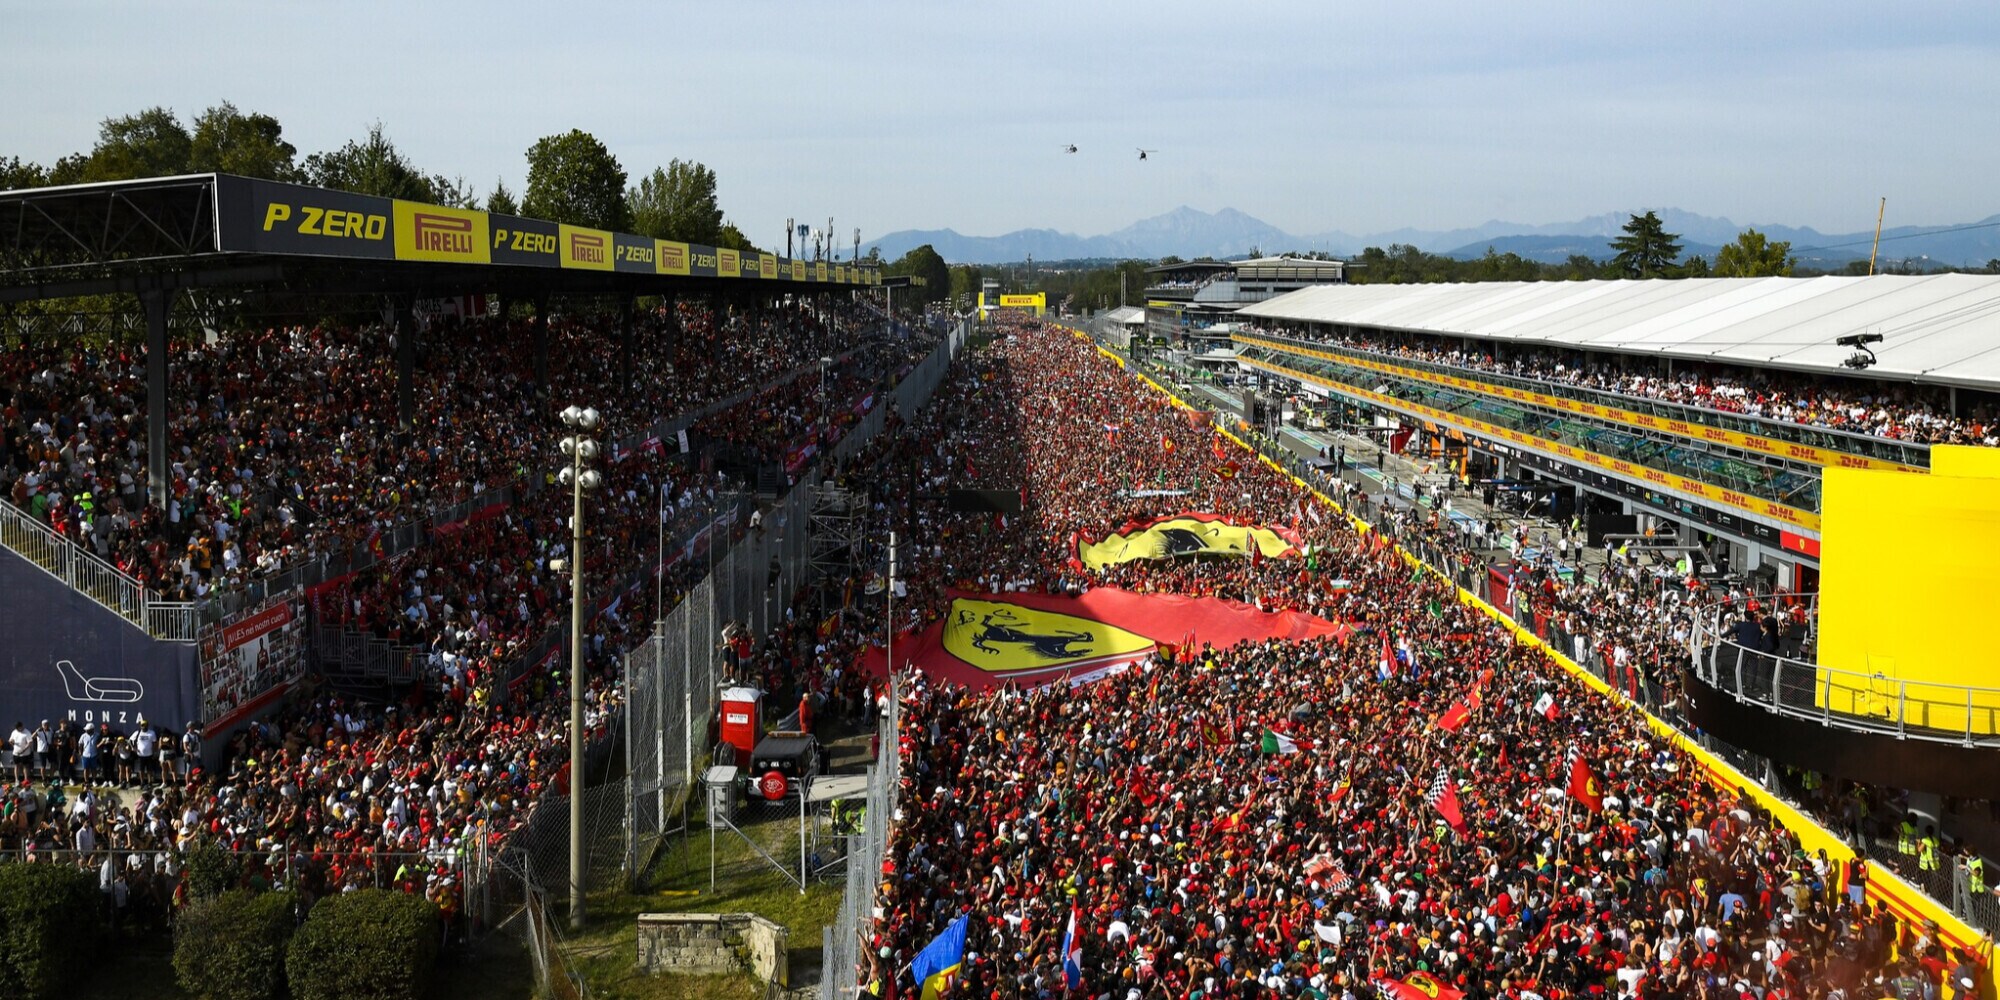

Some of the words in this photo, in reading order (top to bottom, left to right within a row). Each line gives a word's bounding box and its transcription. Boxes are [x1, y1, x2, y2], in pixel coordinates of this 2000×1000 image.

[263, 202, 291, 231] P
[297, 206, 387, 240] ZERO
[414, 213, 473, 253] PIRELLI
[494, 229, 508, 249] P
[511, 231, 557, 254] ZERO
[571, 233, 604, 263] PIRELLI
[616, 245, 624, 260] P
[626, 246, 653, 262] ZERO
[662, 246, 683, 269] PIRELLI
[690, 253, 697, 266] P
[698, 254, 716, 268] ZERO
[721, 253, 736, 272] PIRELLI
[1512, 390, 1525, 399] DHL
[1534, 394, 1547, 404] DHL
[1556, 400, 1571, 409] DHL
[1581, 404, 1596, 414] DHL
[1608, 410, 1625, 420] DHL
[1637, 416, 1656, 426] DHL
[1472, 421, 1484, 430] DHL
[1492, 426, 1504, 436] DHL
[1670, 422, 1690, 434] DHL
[1511, 432, 1524, 442] DHL
[1706, 428, 1728, 442] DHL
[1534, 438, 1546, 448] DHL
[1746, 437, 1771, 451] DHL
[1558, 446, 1573, 457] DHL
[1584, 453, 1602, 464] DHL
[1790, 446, 1818, 460] DHL
[1614, 461, 1632, 473] DHL
[1646, 470, 1666, 484] DHL
[1682, 480, 1705, 494] DHL
[1722, 492, 1749, 506] DHL
[1768, 504, 1797, 520] DHL
[227, 628, 246, 646] JULES
[246, 623, 254, 636] nei
[254, 616, 270, 632] nostri
[270, 609, 285, 626] cuori
[68, 709, 144, 724] MONZA
